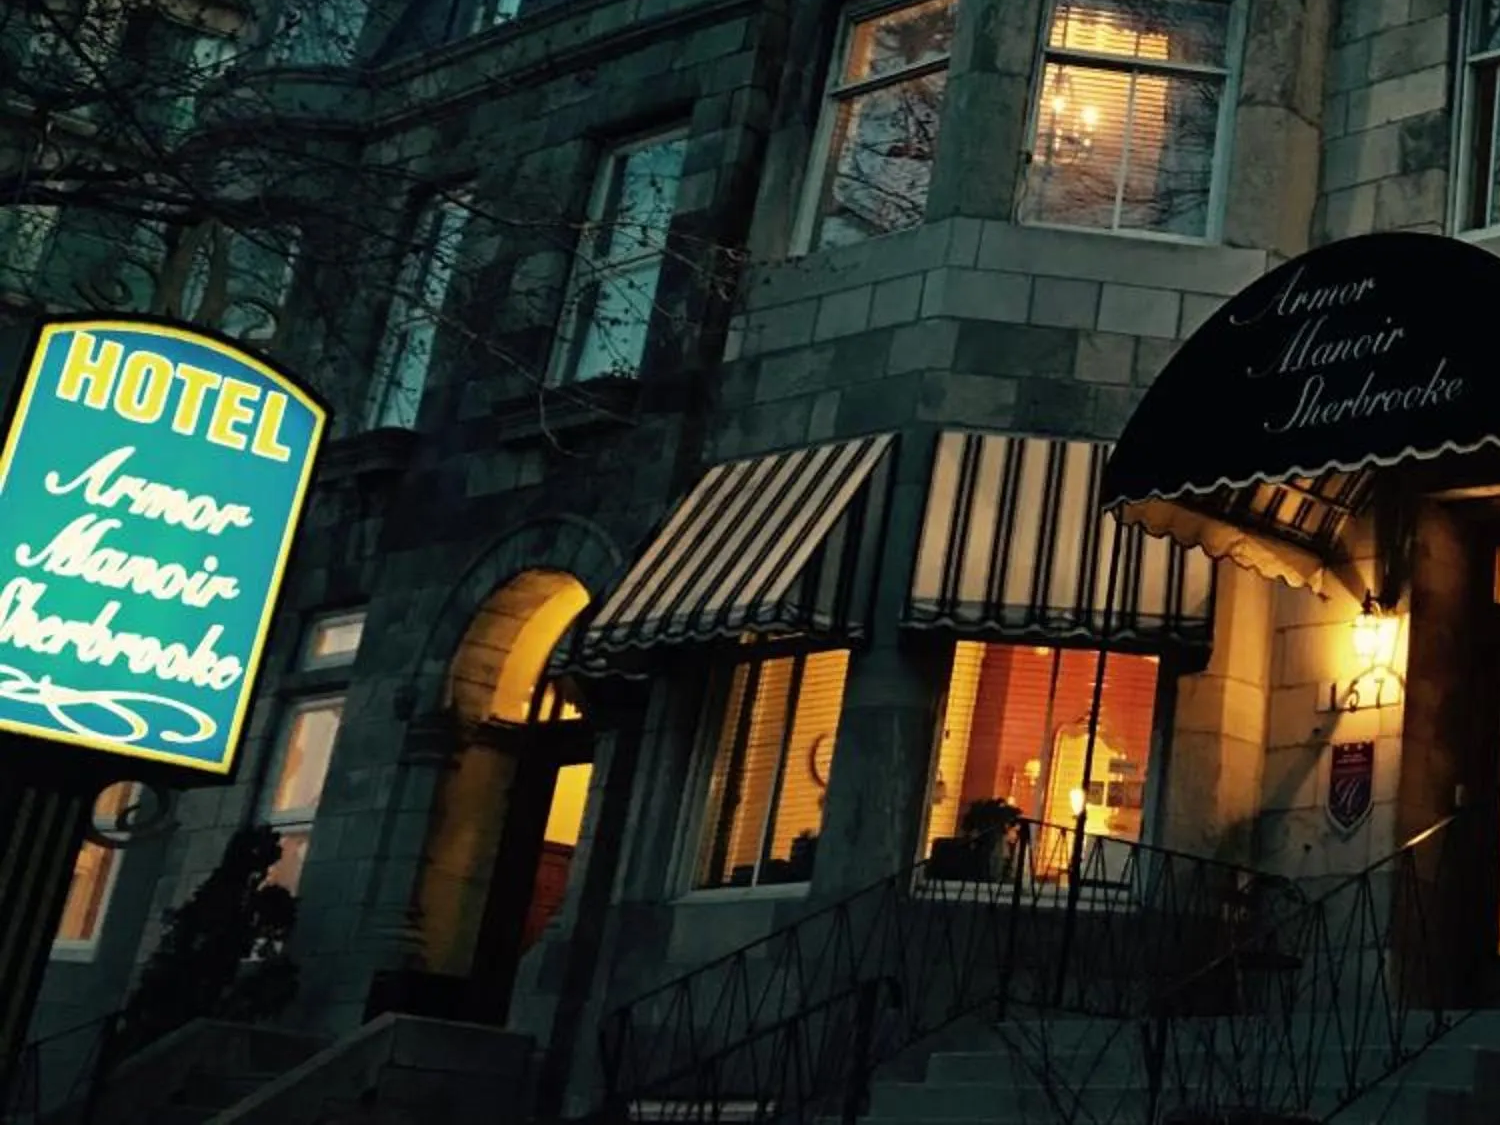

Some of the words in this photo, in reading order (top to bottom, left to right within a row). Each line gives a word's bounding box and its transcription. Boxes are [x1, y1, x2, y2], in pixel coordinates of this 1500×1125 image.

[1229, 262, 1377, 326] Armor
[1245, 314, 1405, 378] Manoir
[55, 331, 292, 462] HOTEL
[1262, 356, 1464, 434] Sherbrooke
[44, 445, 254, 536] Armor
[14, 512, 241, 609] Manoir
